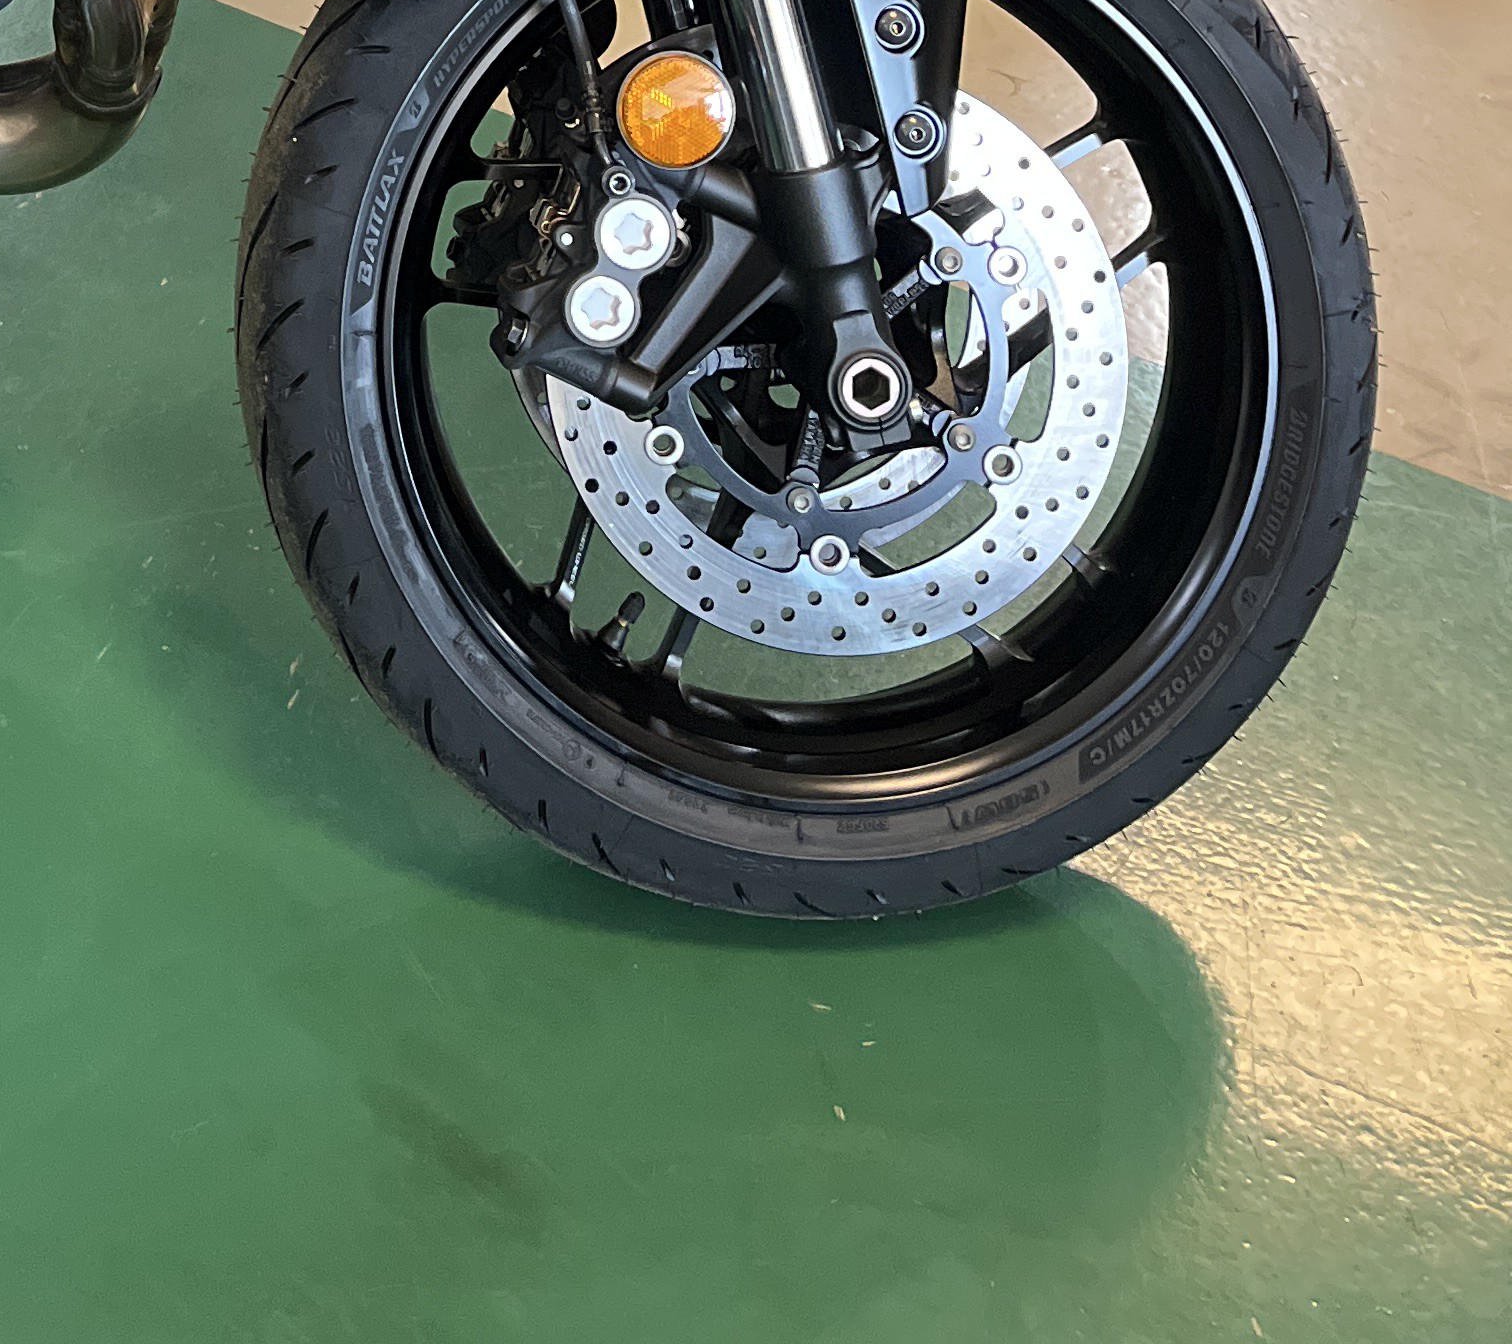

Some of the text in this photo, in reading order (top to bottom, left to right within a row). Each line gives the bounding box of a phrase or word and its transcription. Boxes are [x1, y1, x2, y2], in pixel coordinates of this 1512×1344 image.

[355, 150, 409, 283] BATTLAX
[1253, 406, 1309, 560] BRIDGESTONE
[1086, 622, 1230, 769] 120/70ZR17M/C
